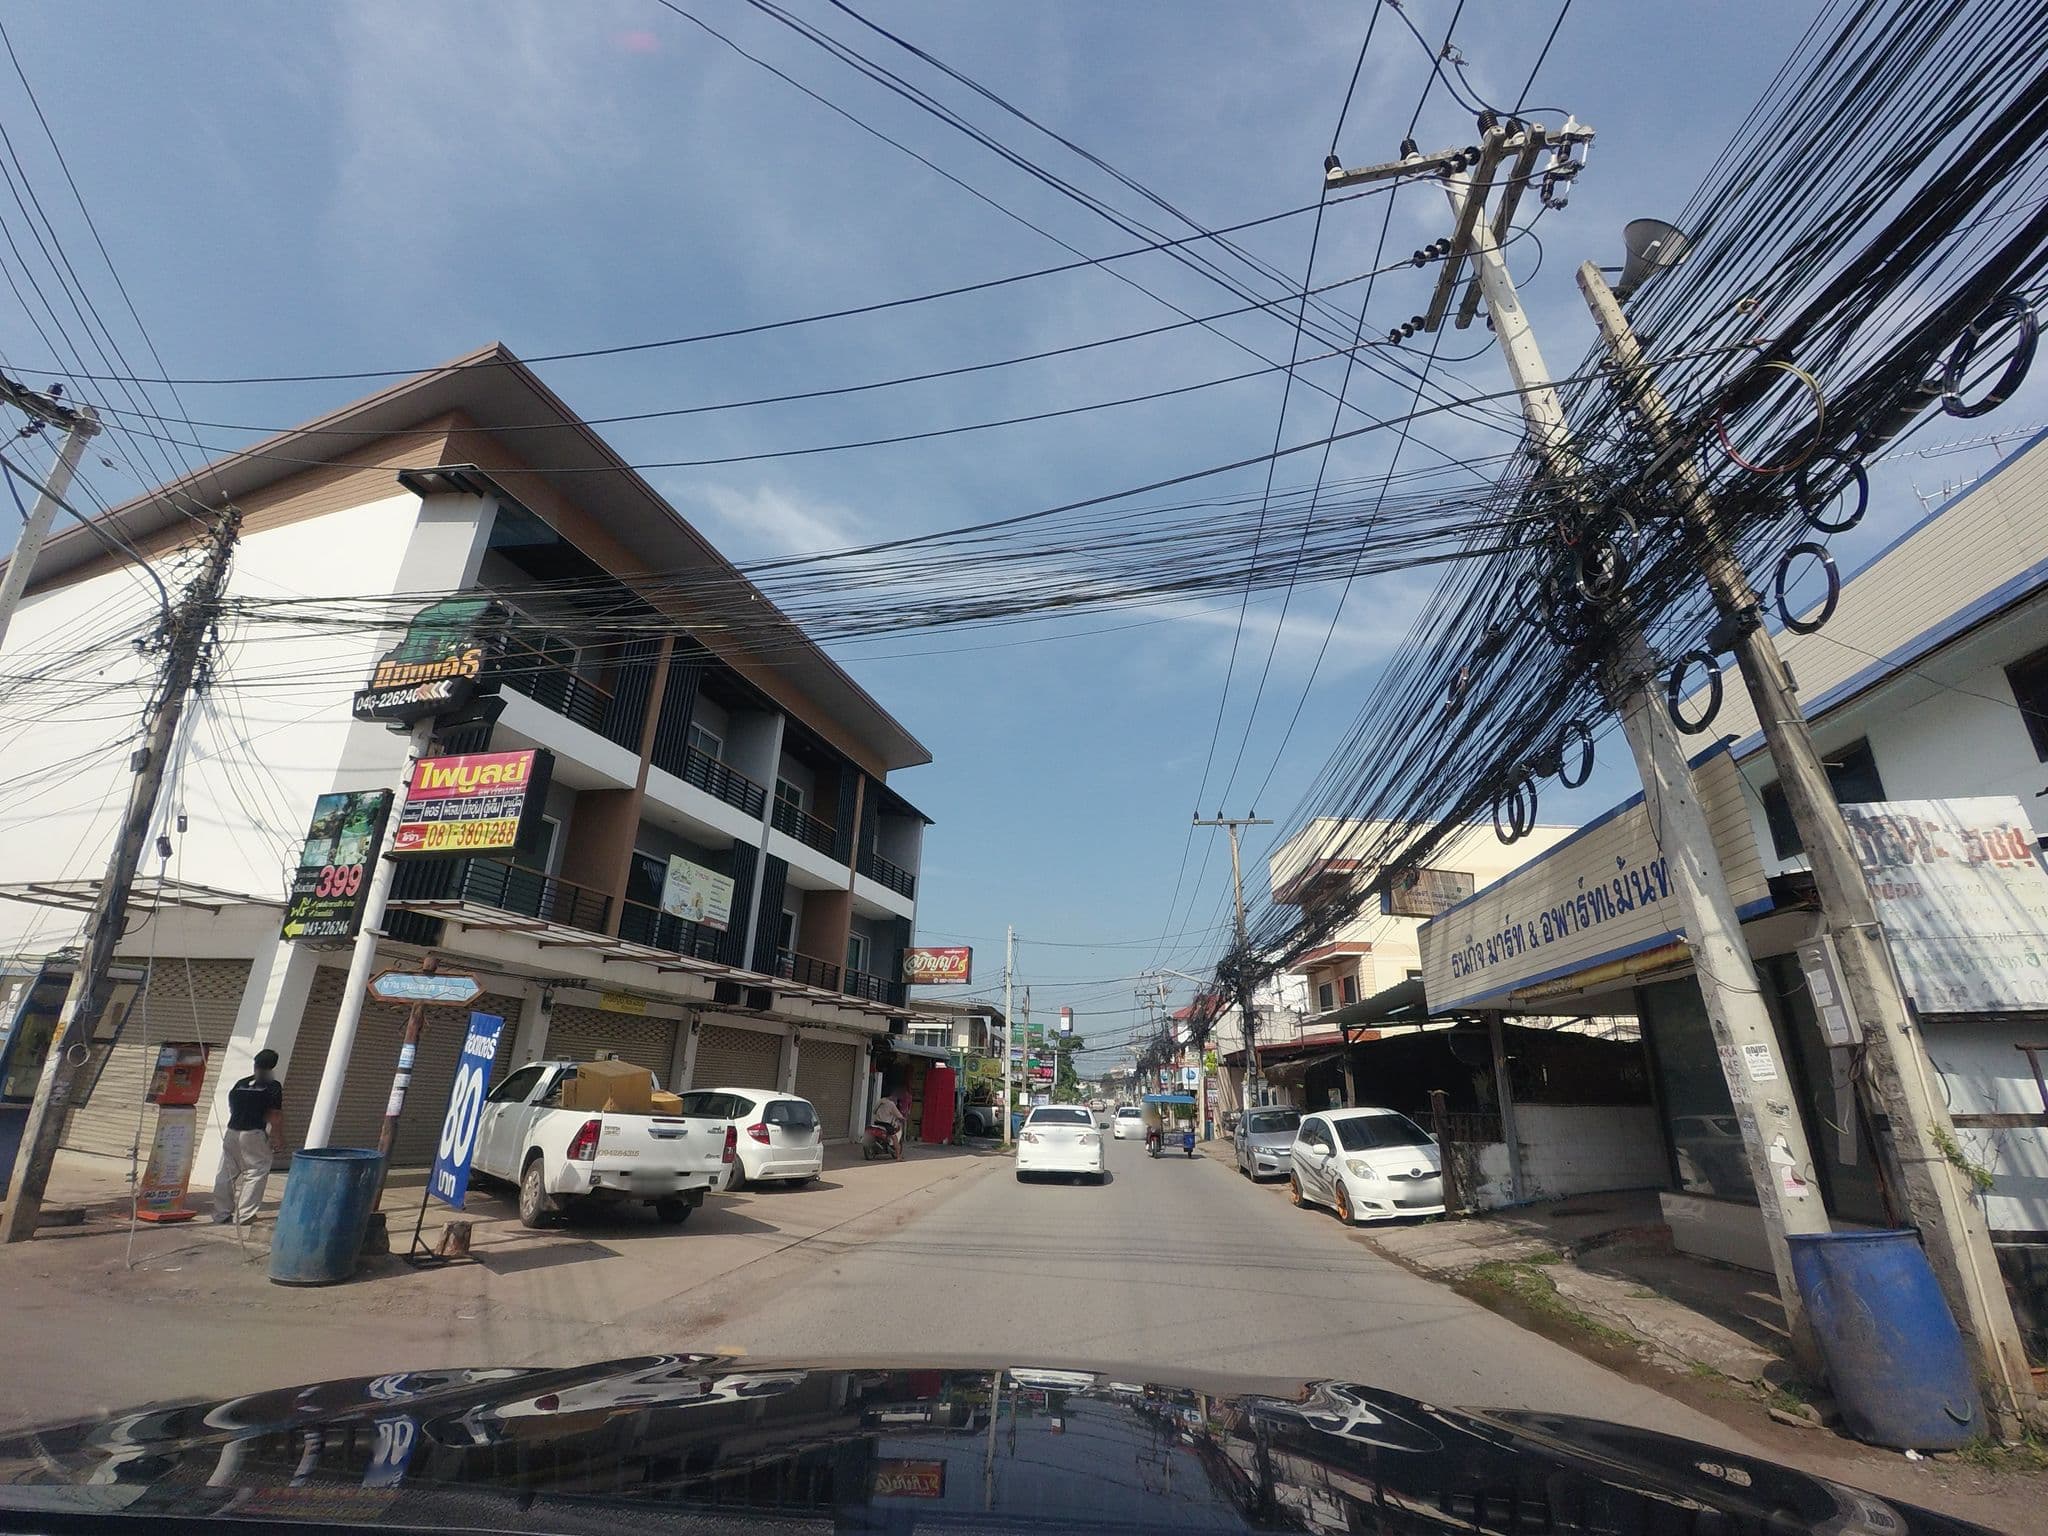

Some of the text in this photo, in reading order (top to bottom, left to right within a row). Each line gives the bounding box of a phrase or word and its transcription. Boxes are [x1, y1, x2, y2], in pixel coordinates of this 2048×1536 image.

[420, 755, 530, 793] ไพบูลย์
[428, 819, 516, 847] 081-3801288
[316, 863, 363, 897] 399
[1487, 914, 1526, 965] มาร์ท
[1527, 921, 1539, 949] &
[439, 1063, 483, 1168] 80
[437, 1169, 456, 1198] บาท
